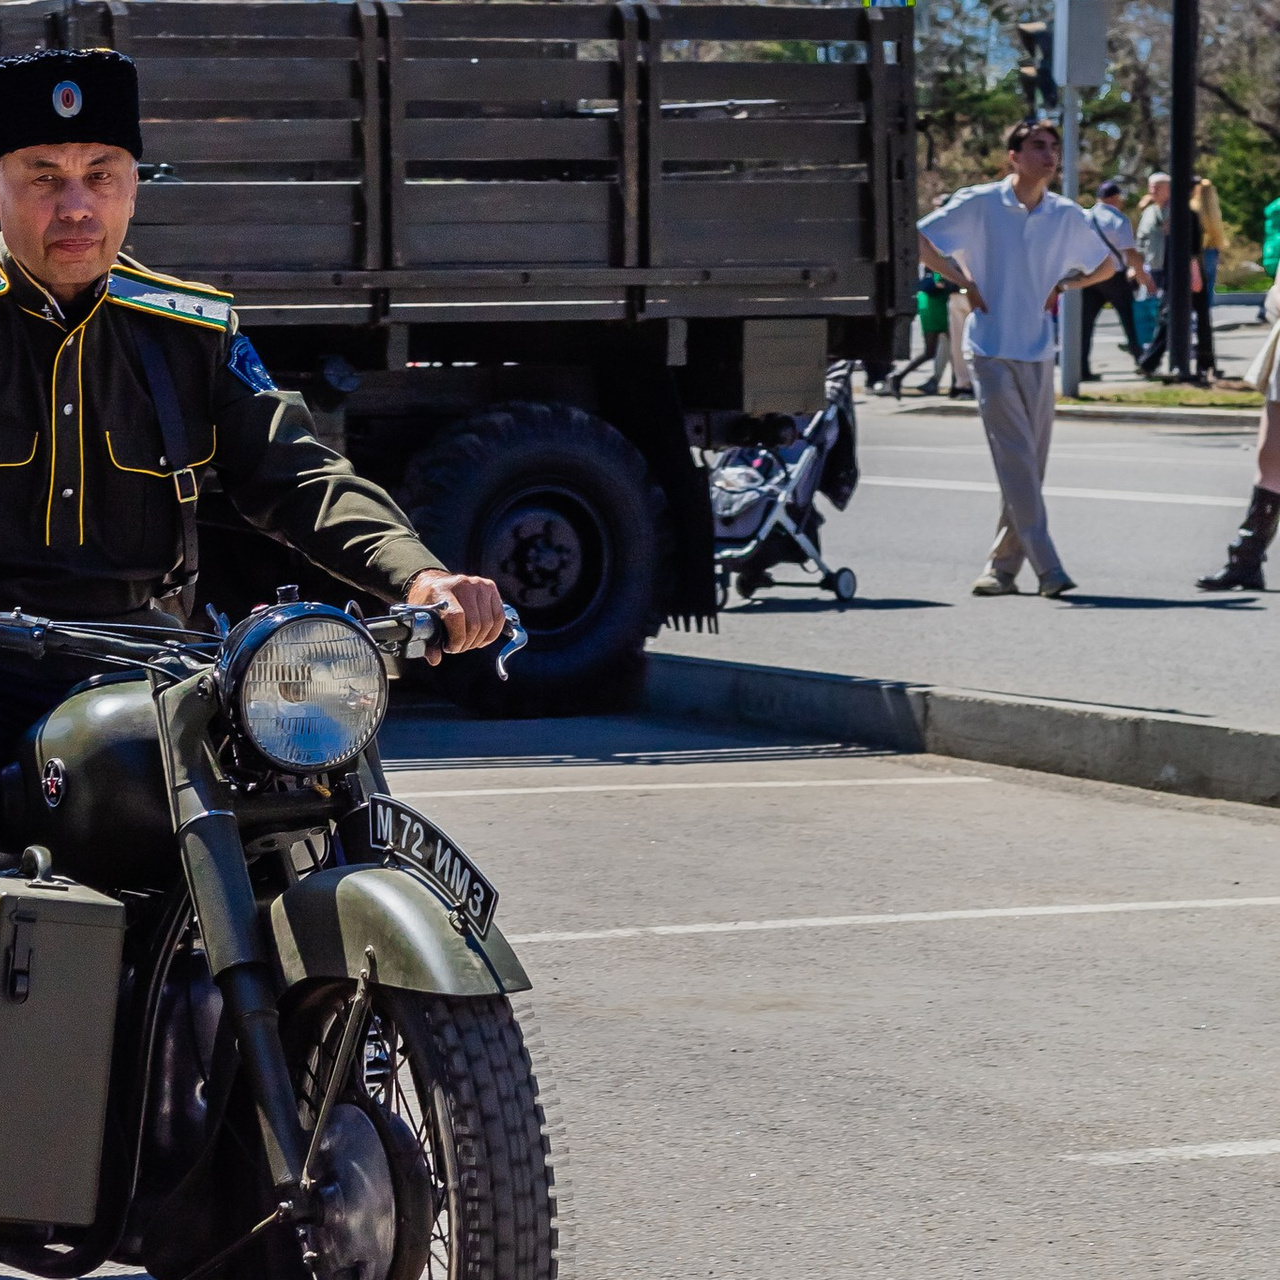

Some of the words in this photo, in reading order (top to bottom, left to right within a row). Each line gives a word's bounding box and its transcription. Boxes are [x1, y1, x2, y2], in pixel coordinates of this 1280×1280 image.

[377, 805, 393, 842] М
[400, 813, 424, 860] 72
[434, 839, 485, 917] ИМЗ
